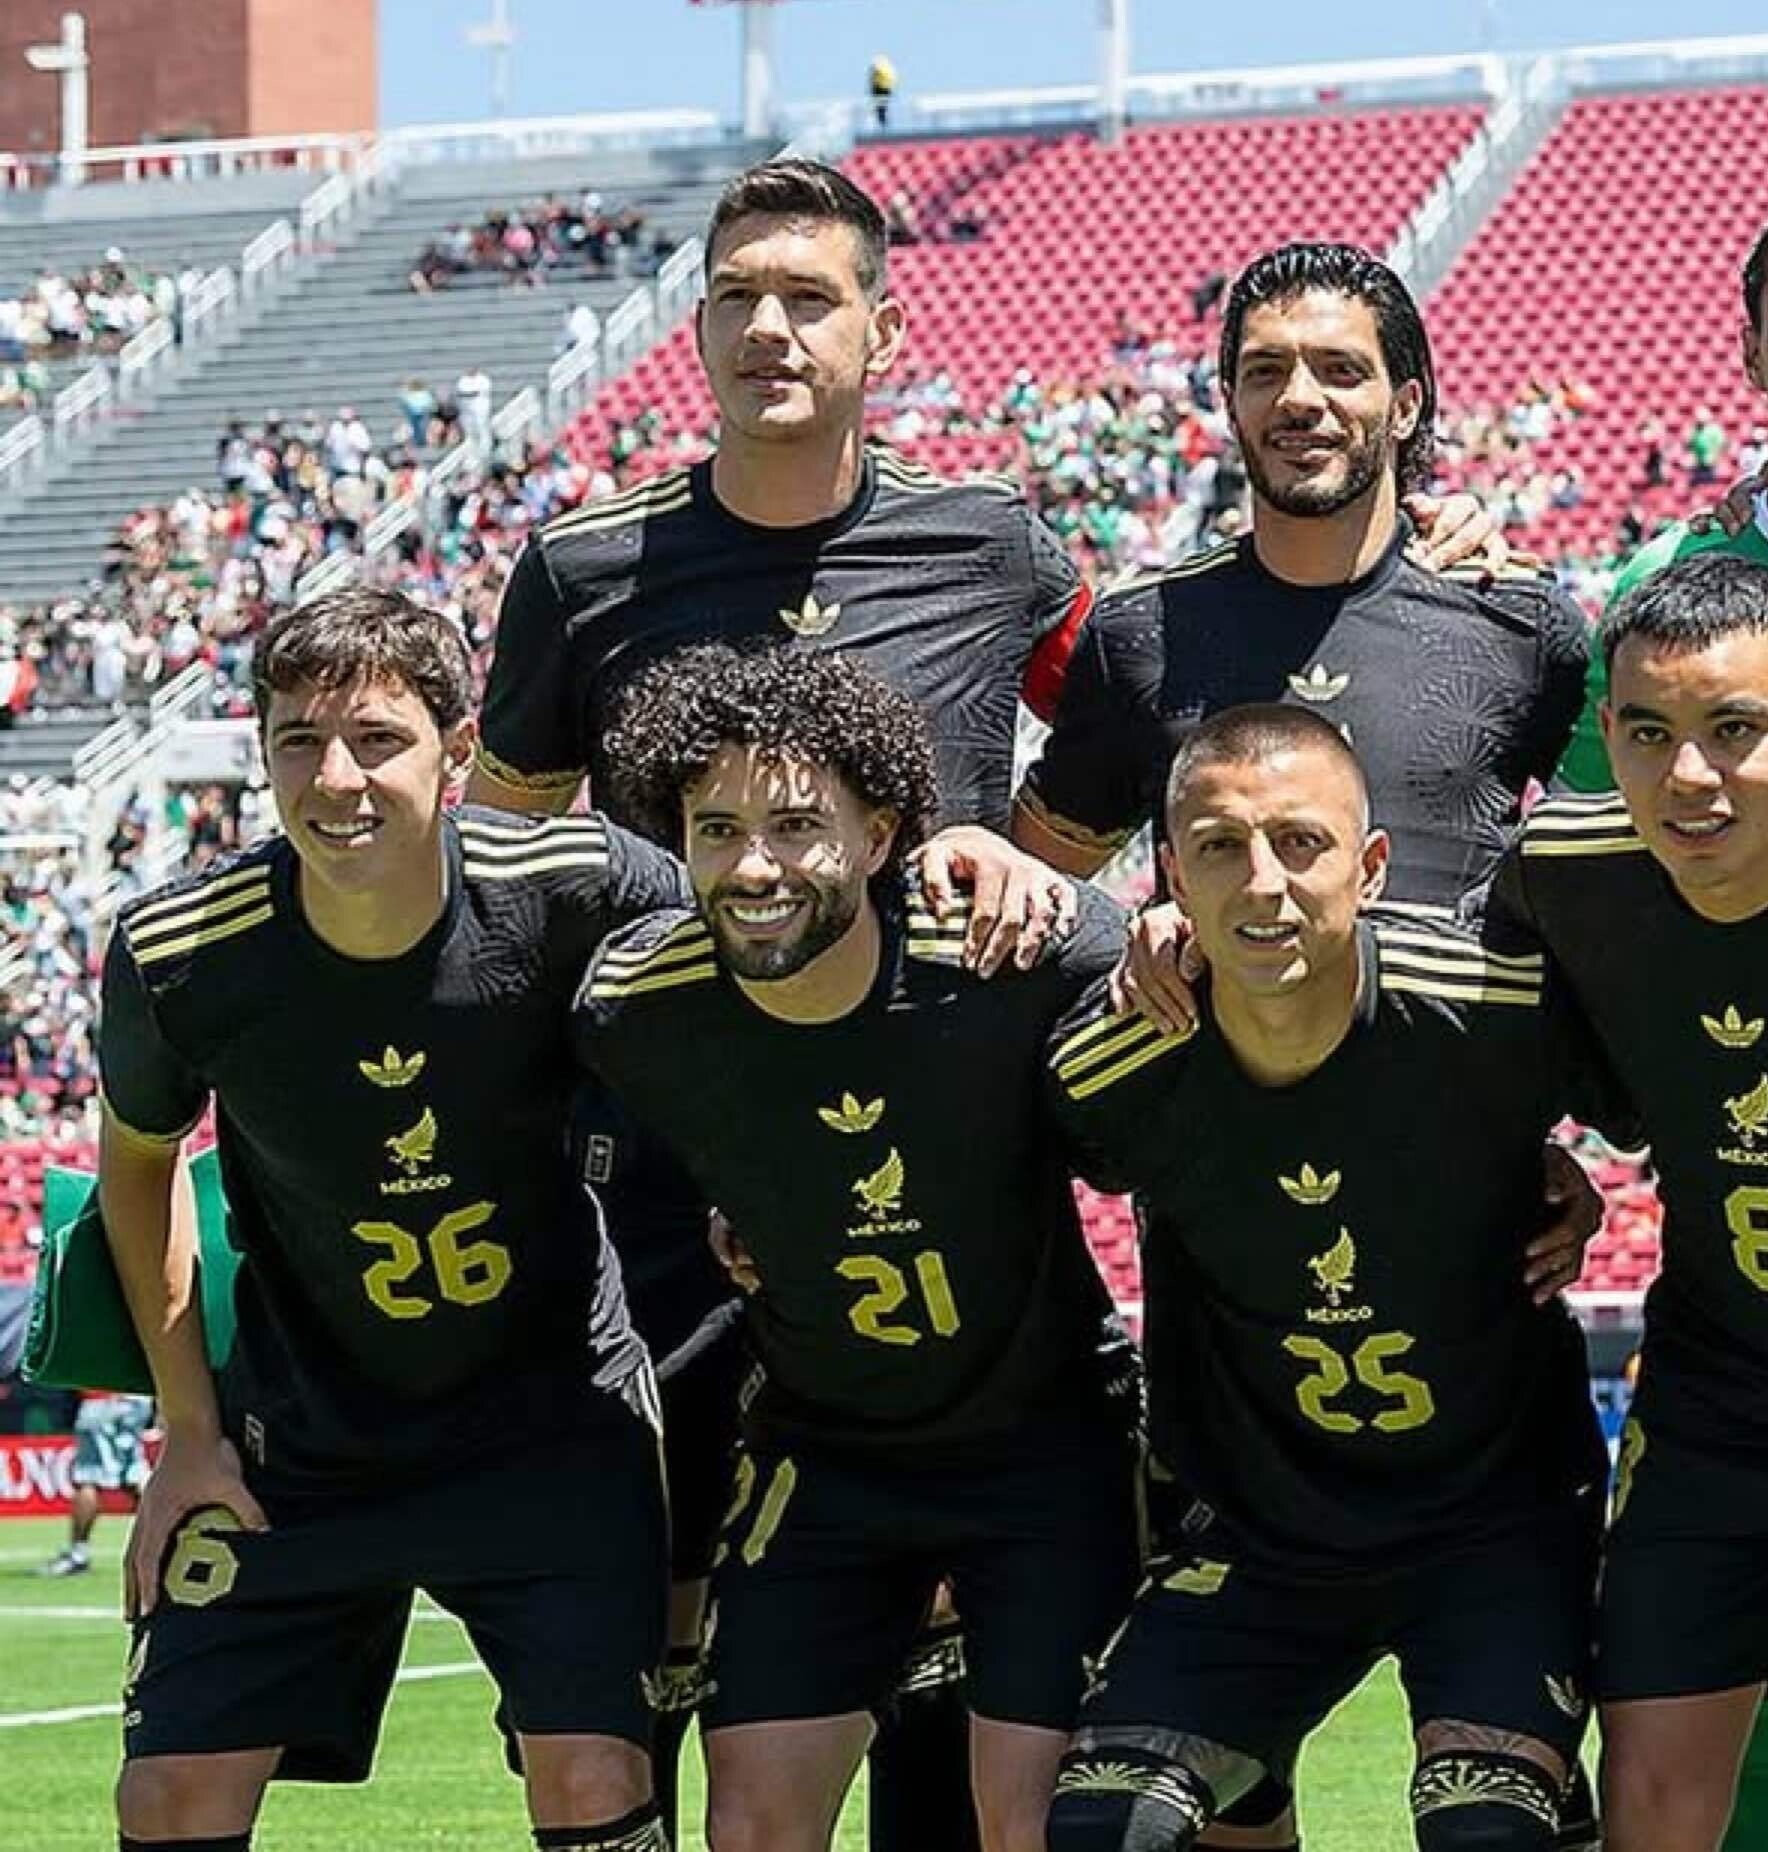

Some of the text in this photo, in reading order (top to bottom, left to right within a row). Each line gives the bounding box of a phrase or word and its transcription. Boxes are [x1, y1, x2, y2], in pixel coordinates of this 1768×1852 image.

[351, 1202, 513, 1318] 26
[834, 1251, 960, 1345] 21
[1281, 1330, 1435, 1432] 25
